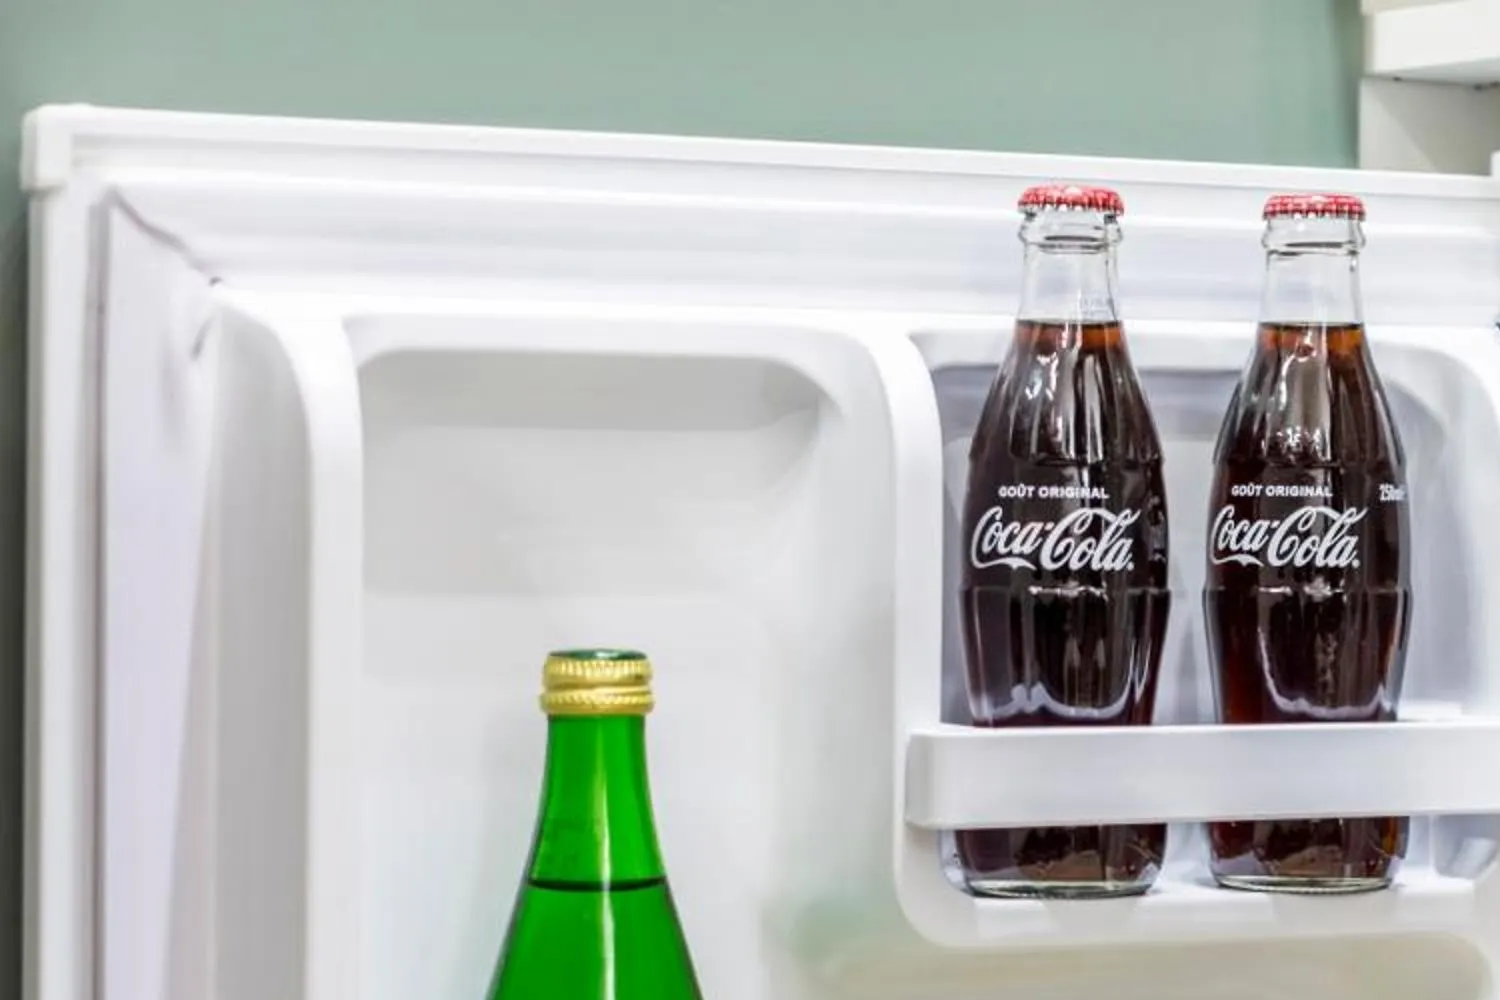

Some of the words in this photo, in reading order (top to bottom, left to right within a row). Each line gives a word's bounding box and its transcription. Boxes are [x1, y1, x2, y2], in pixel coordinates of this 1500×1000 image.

[998, 483, 1034, 498] GOÛT
[1038, 486, 1110, 499] ORIGINAL
[1231, 483, 1262, 497] GOÛT
[1265, 485, 1333, 497] ORIGINAL
[971, 506, 1142, 571] Coca-Cola
[1210, 505, 1368, 568] Coca-Cola
